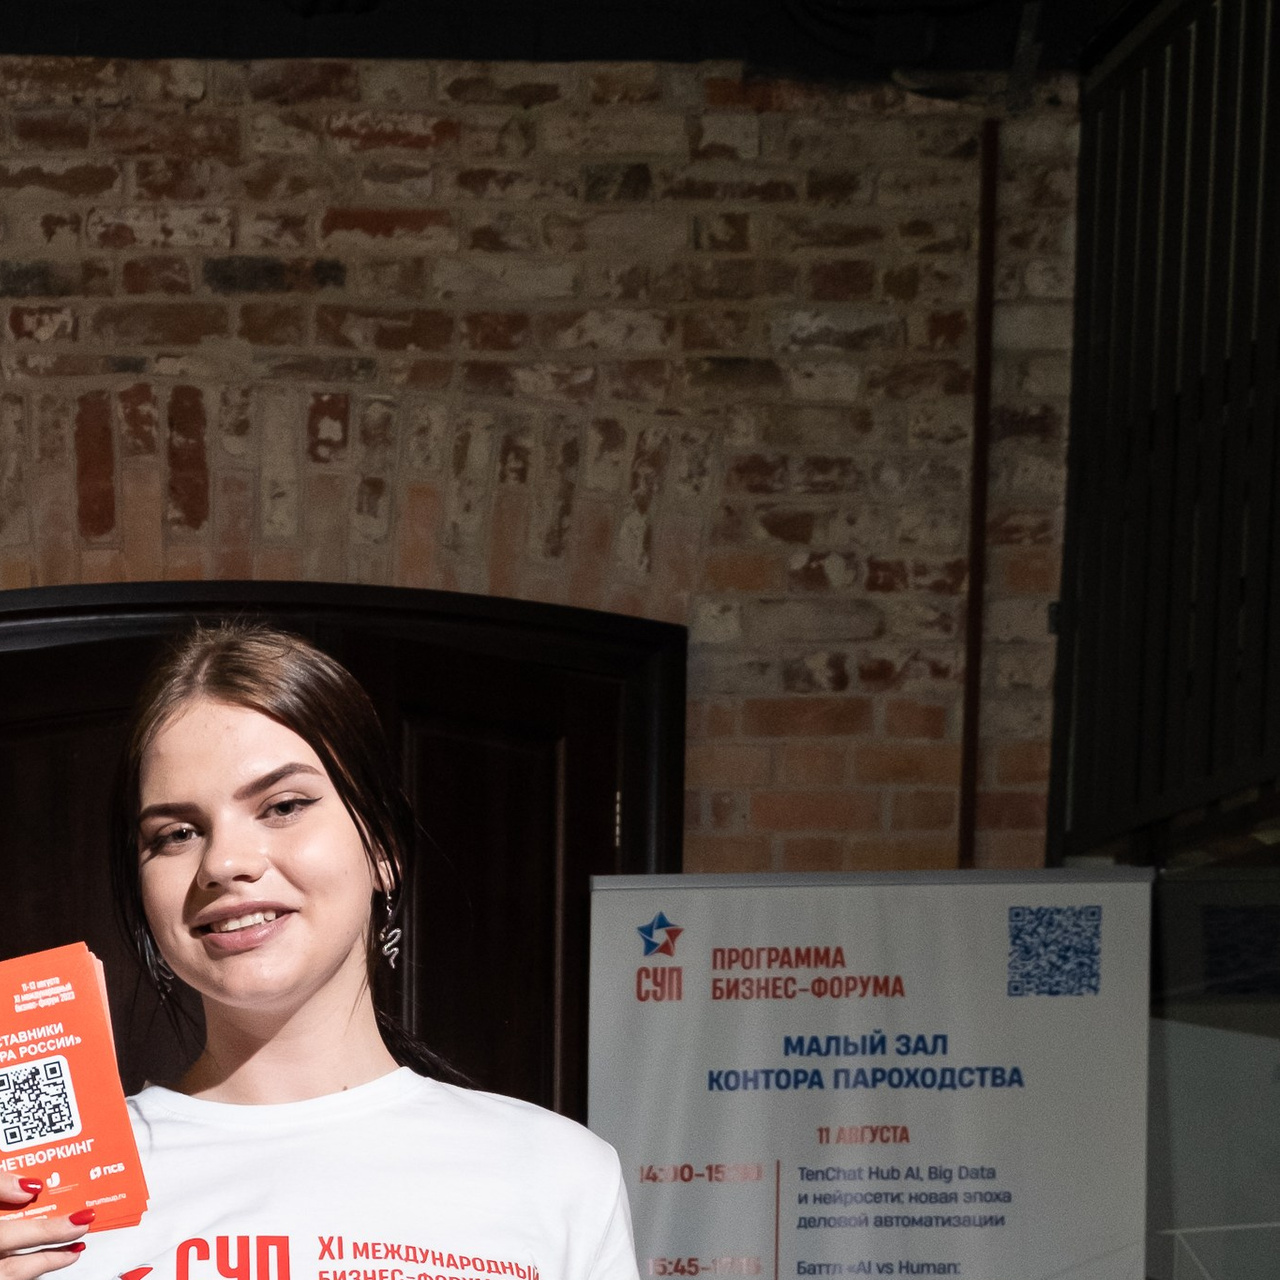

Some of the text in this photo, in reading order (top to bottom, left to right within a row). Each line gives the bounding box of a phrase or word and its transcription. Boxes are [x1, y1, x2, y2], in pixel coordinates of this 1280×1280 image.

[712, 946, 846, 971] ПРОГРАММА
[636, 966, 682, 1002] СУП
[711, 976, 905, 1001] БИЗНЕС-ФОРУМА
[19, 1035, 82, 1058] РОССИИ»
[783, 1029, 949, 1056] МАЛЫЙ ЗАЛ
[707, 1066, 1025, 1092] КОНТОРА ПАРОХОДСТВА
[817, 1125, 910, 1145] 11 АВГУСТА
[798, 1166, 863, 1182] TenChat
[868, 1166, 901, 1182] Hub
[928, 1166, 953, 1184] Big
[958, 1166, 997, 1181] Data
[797, 1192, 808, 1205] и
[908, 1191, 958, 1205] новая
[963, 1190, 1013, 1204] эпоха
[873, 1215, 1006, 1230] автоматизации
[318, 1236, 344, 1261] XI
[876, 1262, 894, 1276] vs
